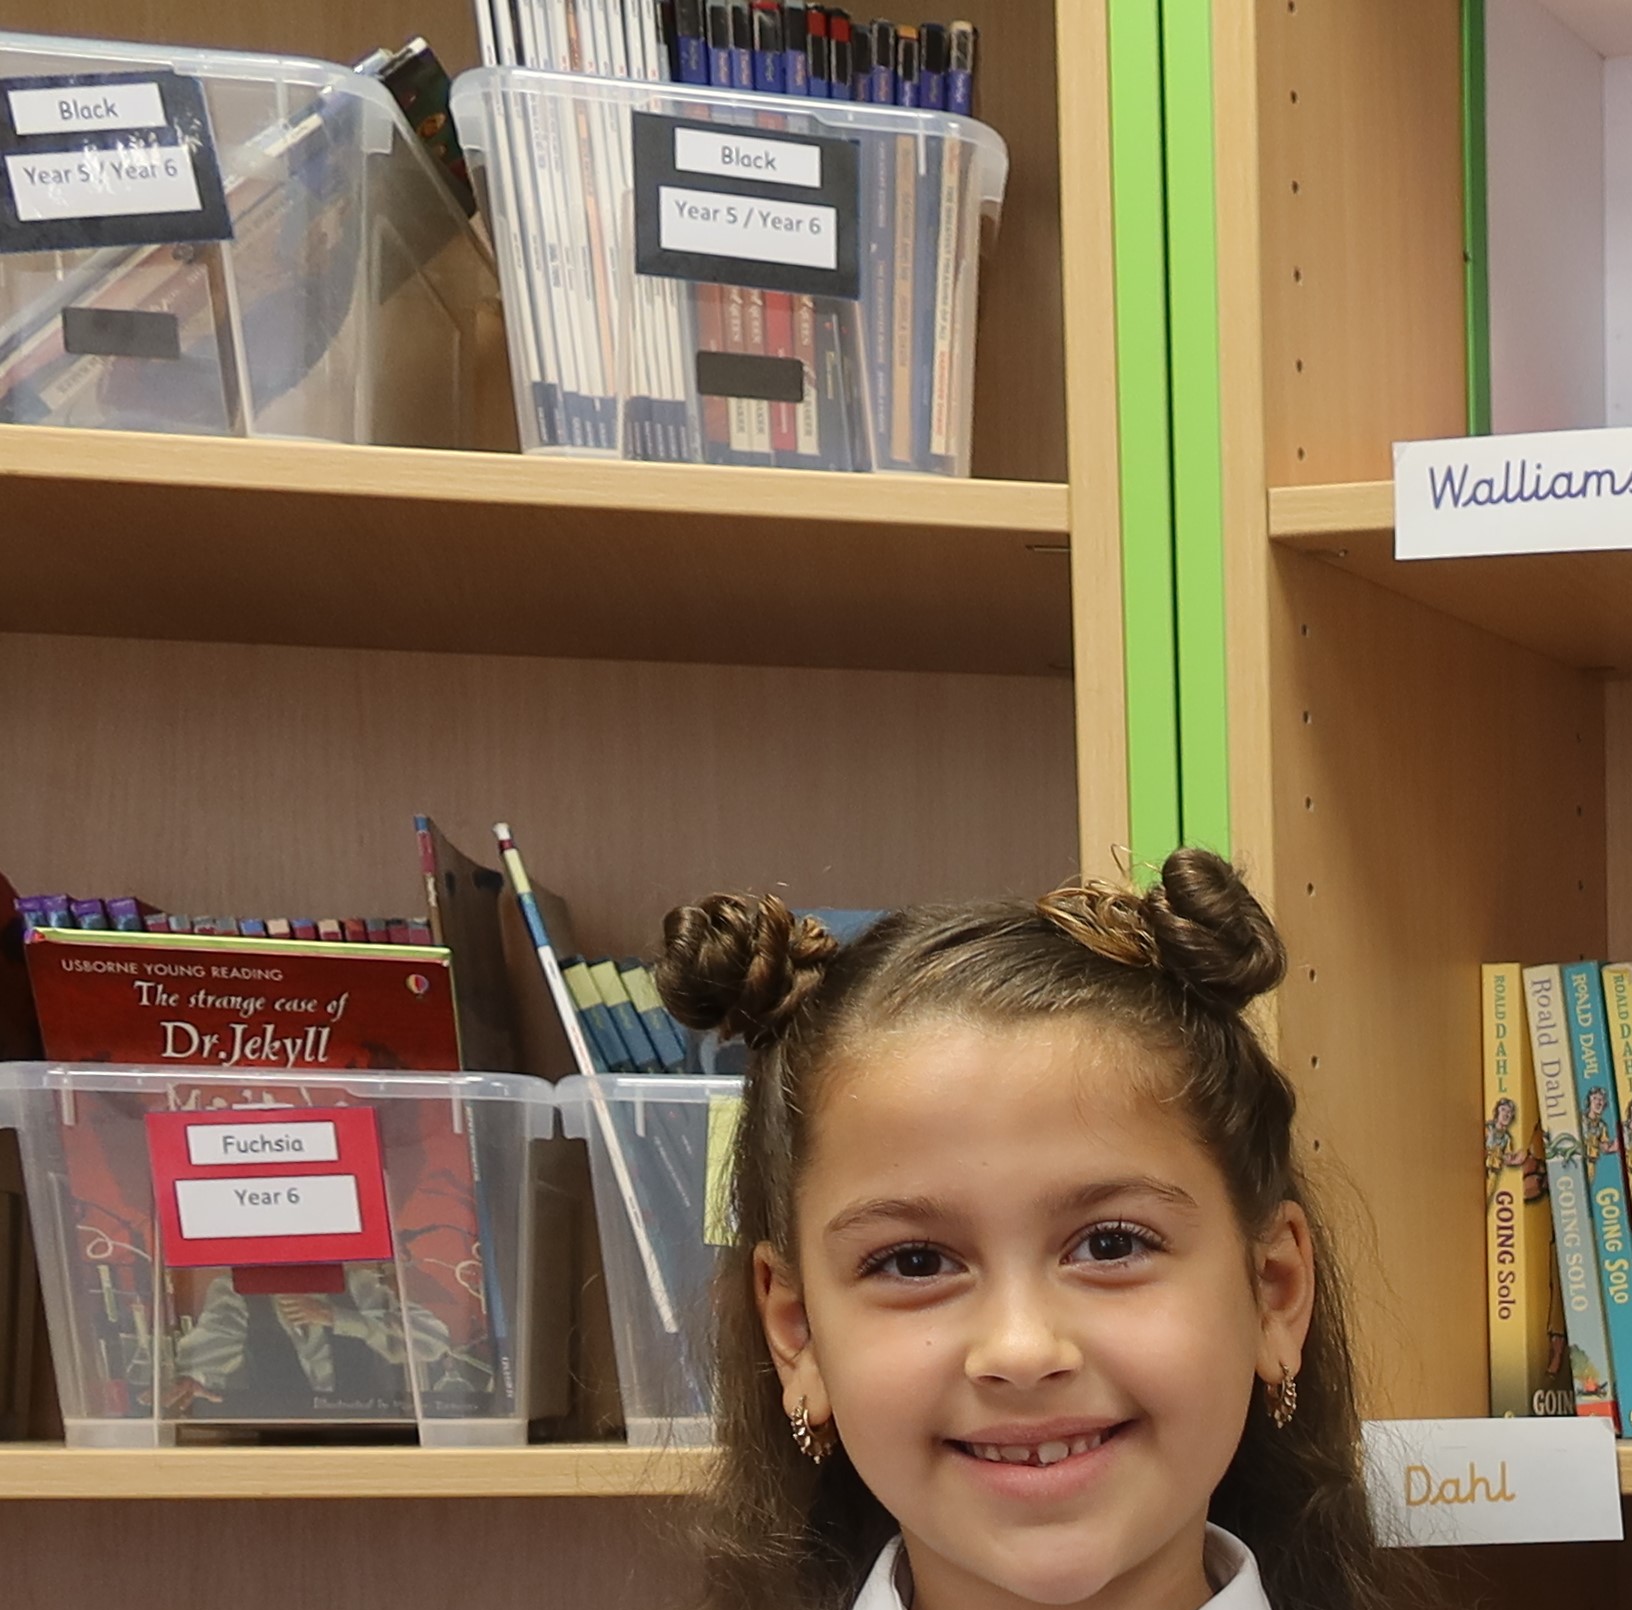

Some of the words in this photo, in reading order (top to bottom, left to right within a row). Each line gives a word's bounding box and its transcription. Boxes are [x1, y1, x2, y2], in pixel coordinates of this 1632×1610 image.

[58, 97, 119, 121] Black
[24, 165, 72, 185] Year
[78, 163, 91, 183] 5
[111, 160, 159, 181] Year
[164, 157, 178, 178] 6
[720, 145, 778, 172] Black
[674, 199, 721, 222] Year
[726, 206, 739, 225] 5
[758, 209, 804, 233] Year
[809, 216, 822, 236] 6
[60, 958, 139, 975] USBORNE
[143, 962, 207, 978] YOUNG
[210, 965, 284, 982] READING
[133, 979, 180, 1008] The
[188, 988, 265, 1019] strange
[274, 996, 319, 1014] case
[326, 991, 349, 1023] of
[1493, 974, 1507, 1020] ROALD
[1531, 977, 1560, 1050] Roald
[1571, 972, 1594, 1030] ROALD
[1613, 974, 1631, 1021] ROALD
[1493, 1021, 1508, 1095] DAHL
[1579, 1031, 1600, 1081] DAHL
[1542, 1058, 1567, 1121] Dahl
[221, 1134, 304, 1155] Fuchsia
[233, 1188, 282, 1207] Year
[286, 1187, 300, 1204] 6
[1556, 1174, 1583, 1246] GOING
[1595, 1186, 1623, 1254] GOING
[1495, 1190, 1517, 1267] GOING
[1496, 1270, 1517, 1321] Solo
[1564, 1247, 1589, 1313] SOLO
[1403, 1462, 1517, 1508] Dahl
